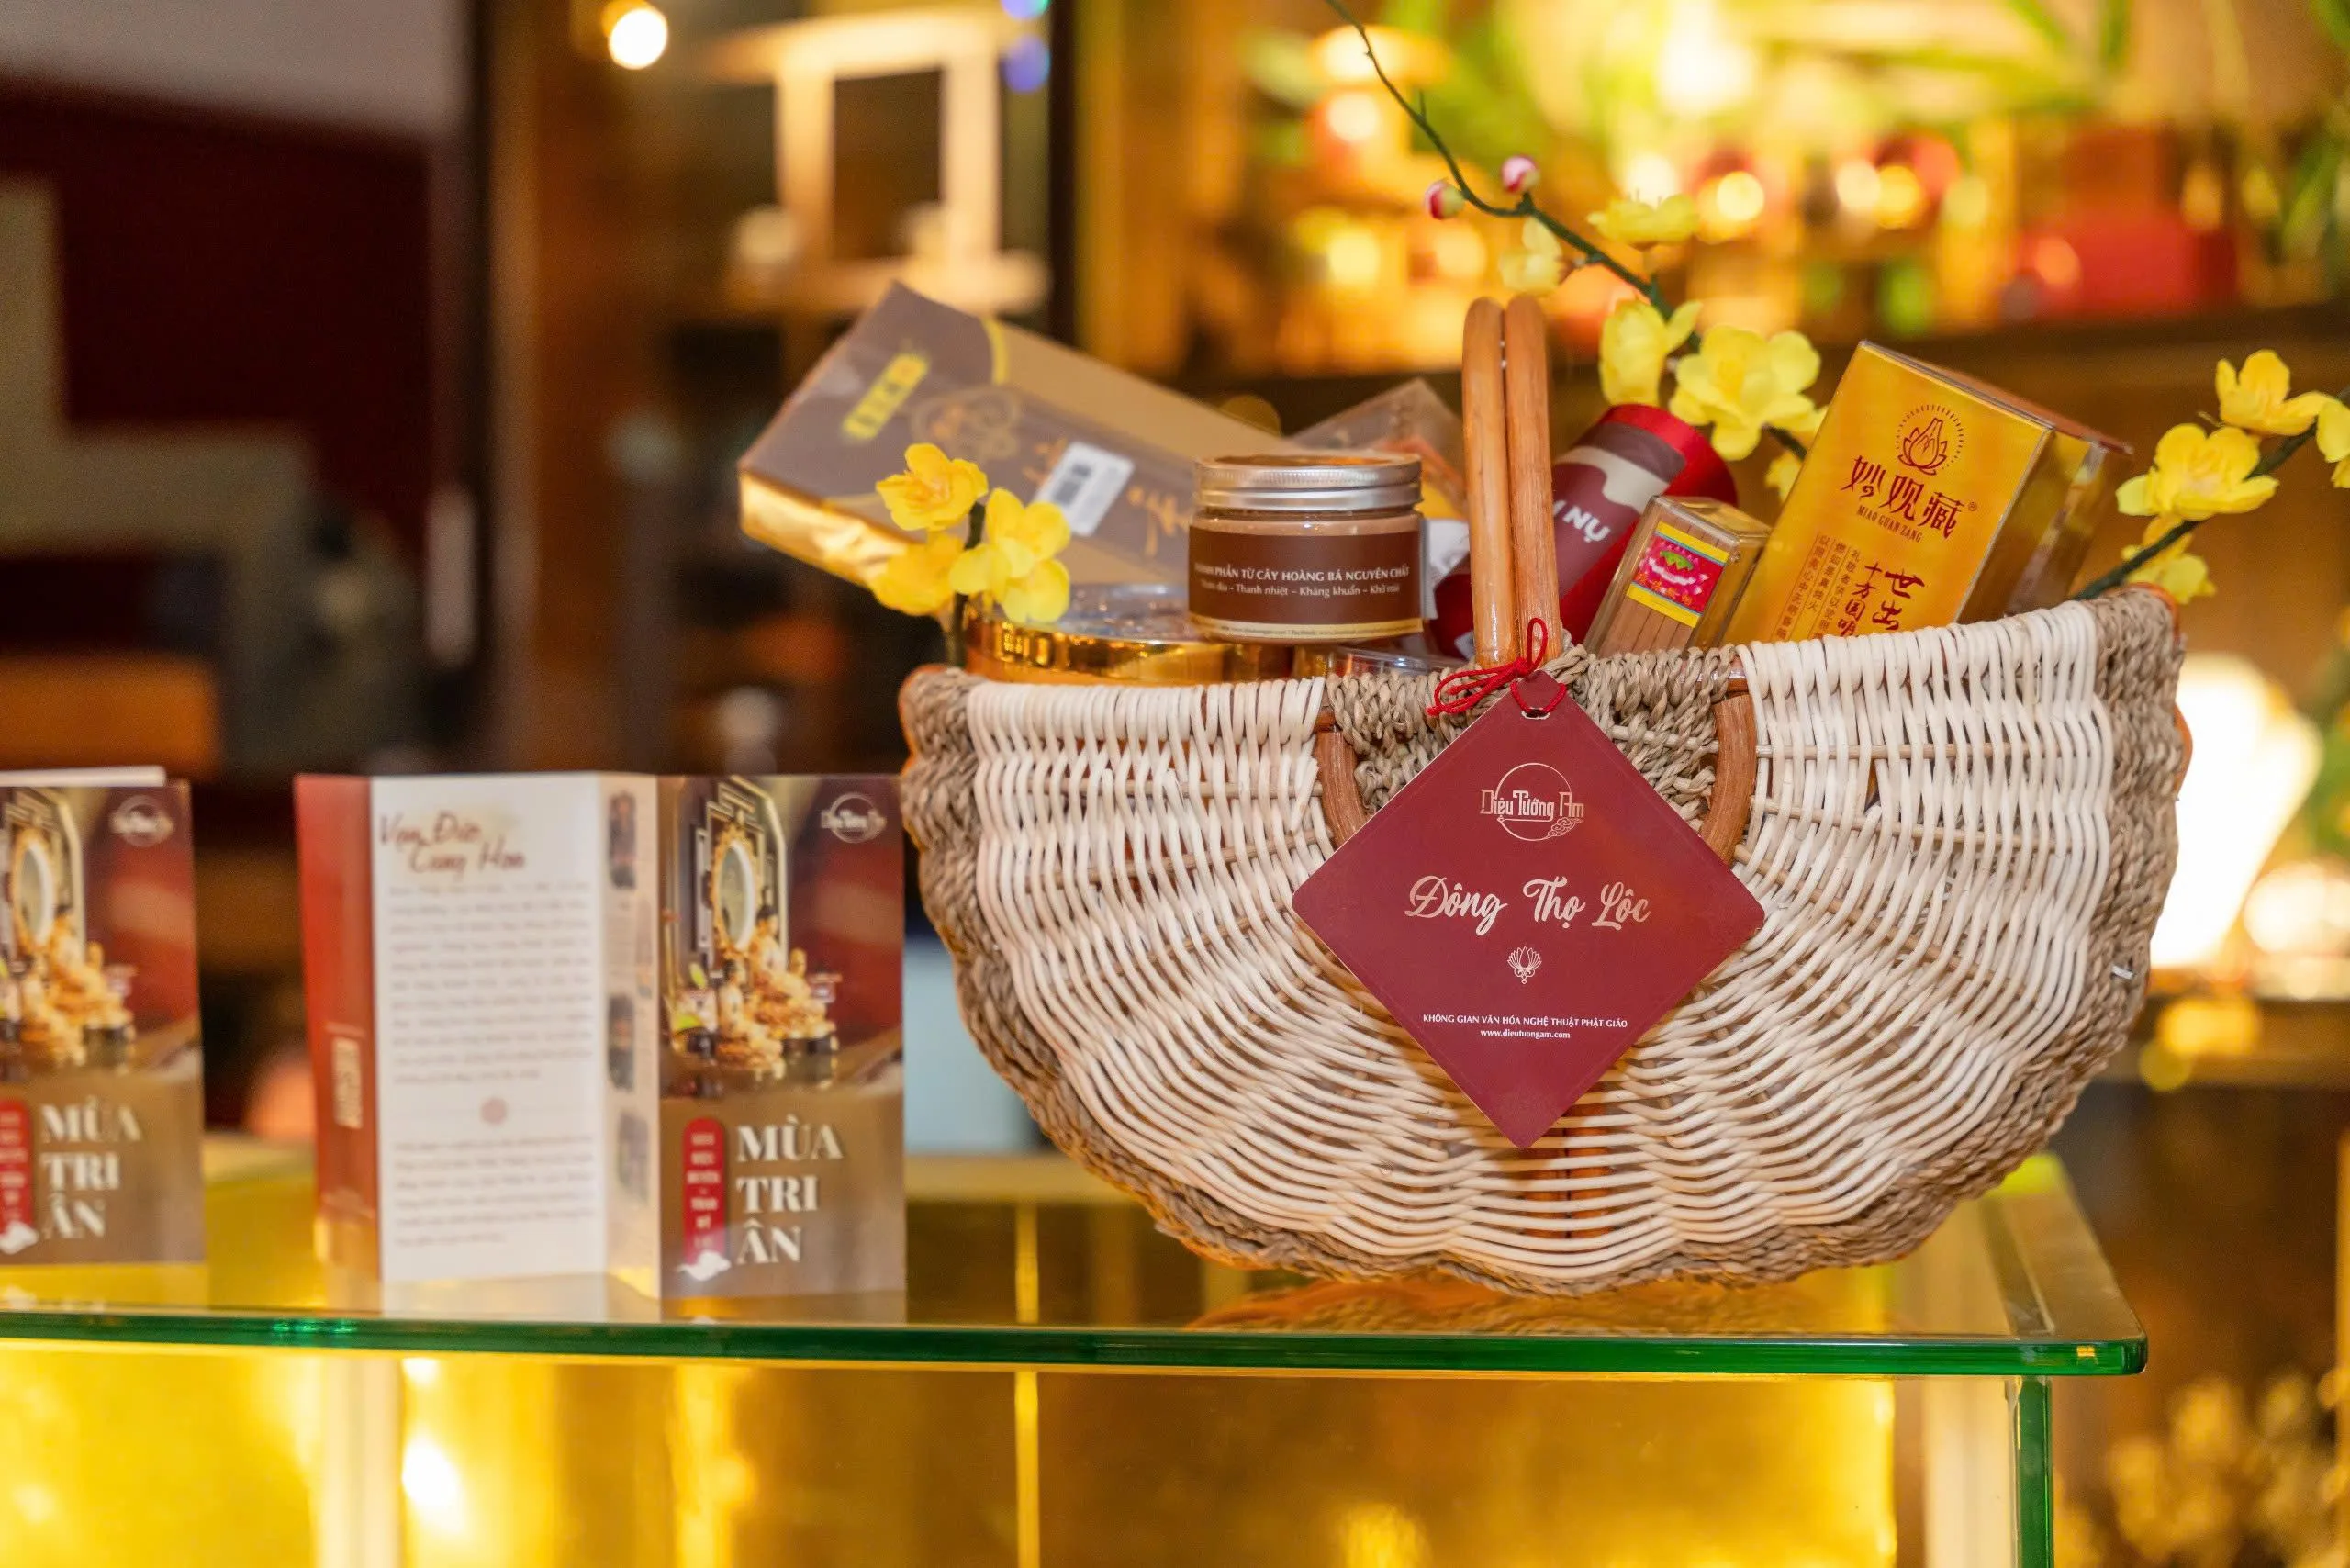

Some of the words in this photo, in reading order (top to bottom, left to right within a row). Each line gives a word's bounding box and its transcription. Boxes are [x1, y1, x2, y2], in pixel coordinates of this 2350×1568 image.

[1856, 505, 1878, 522] MIAO
[1877, 514, 1899, 532] GUAN
[1900, 525, 1923, 543] ZANG
[1236, 583, 1262, 595] Thanh
[1281, 569, 1324, 581] HOÀNG
[1559, 791, 1584, 818] Am
[1522, 875, 1586, 930] Thọ
[1423, 1013, 1455, 1023] KHÔNG
[1457, 1014, 1479, 1024] GIAN
[1482, 1014, 1500, 1024] VĂN
[1502, 1014, 1521, 1025] HÓA
[1523, 1015, 1549, 1027] NGHỆ
[1550, 1016, 1579, 1028] THUẬT
[1581, 1017, 1604, 1029] PHẬT
[1606, 1017, 1628, 1028] GIÁO
[1480, 1028, 1571, 1040] www.dieutuongam.com
[737, 1114, 844, 1163] MÙA
[39, 1151, 120, 1192] TRI
[736, 1175, 819, 1214] TRI
[736, 1217, 802, 1265] ÂN
